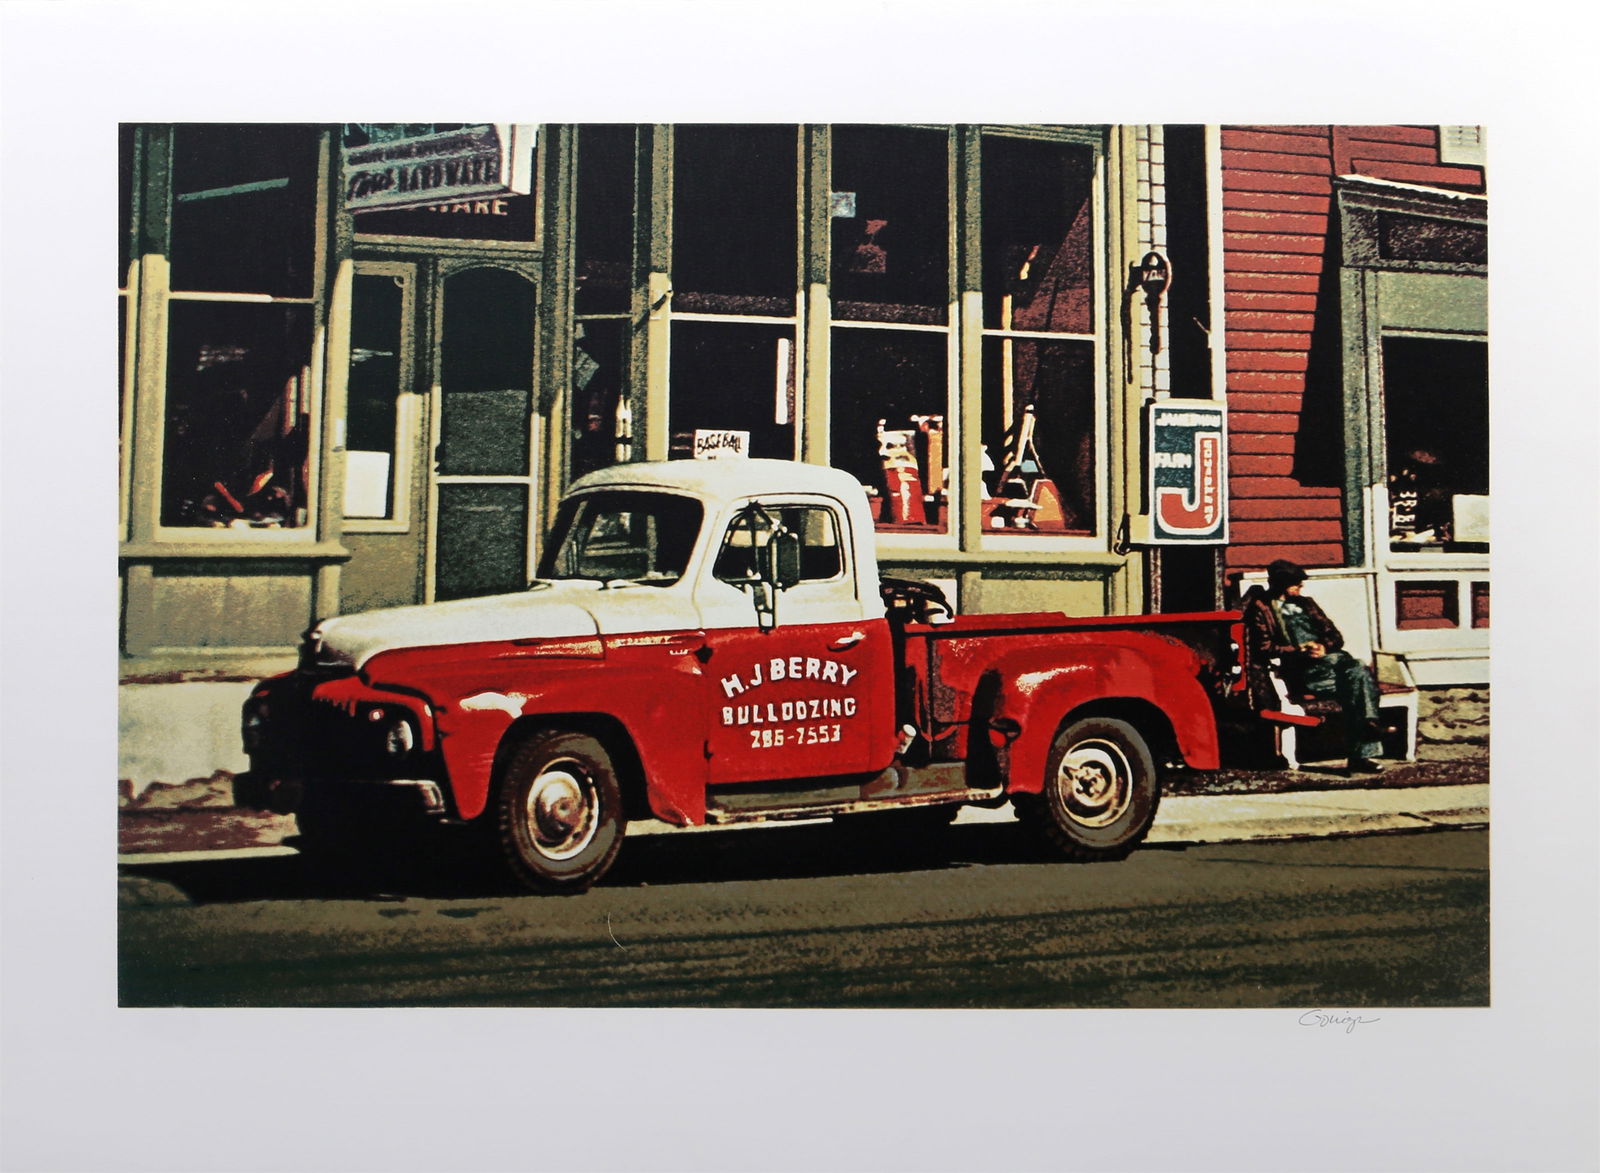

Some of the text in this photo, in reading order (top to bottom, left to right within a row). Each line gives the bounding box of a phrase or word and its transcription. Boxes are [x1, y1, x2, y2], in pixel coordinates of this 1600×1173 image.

[770, 656, 857, 686] BERRY
[722, 697, 857, 725] BULLDOZING
[750, 724, 841, 749] 286-7553
